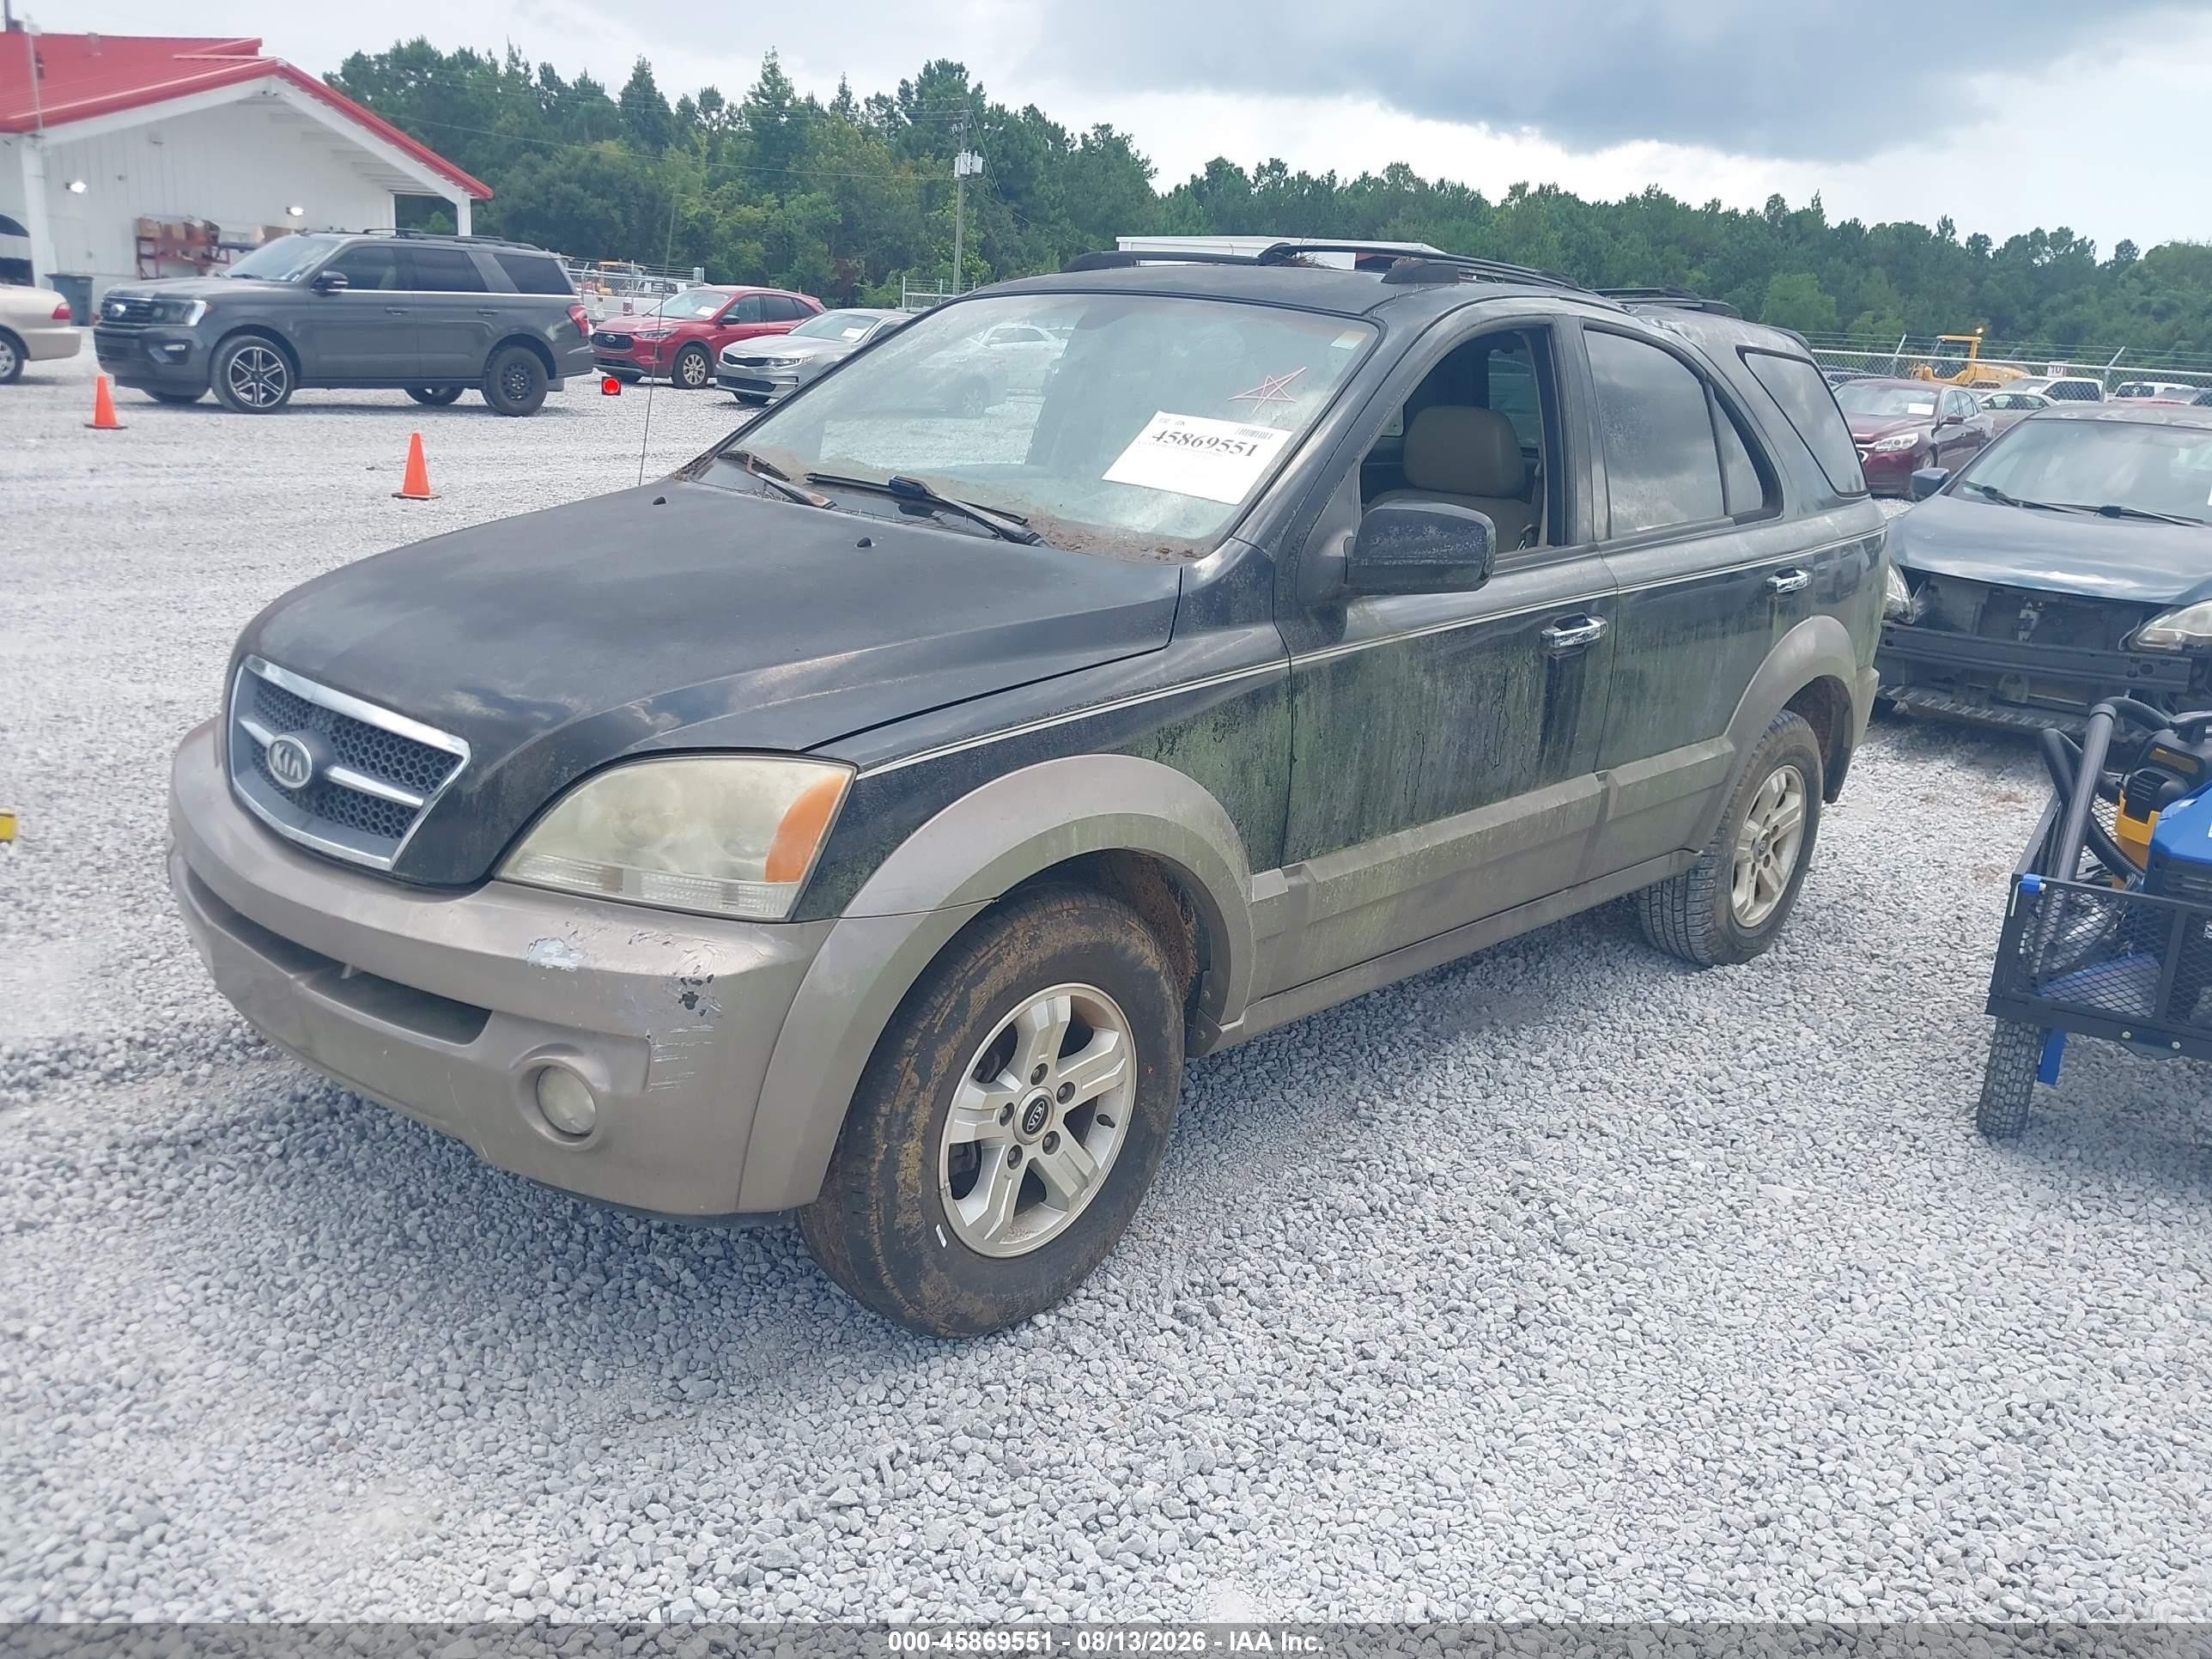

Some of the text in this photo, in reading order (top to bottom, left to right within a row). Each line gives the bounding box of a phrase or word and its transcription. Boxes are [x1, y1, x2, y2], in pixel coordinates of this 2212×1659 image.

[1152, 429, 1259, 457] 45869551
[271, 742, 303, 781] KIA
[1030, 1106, 1043, 1127] KIA
